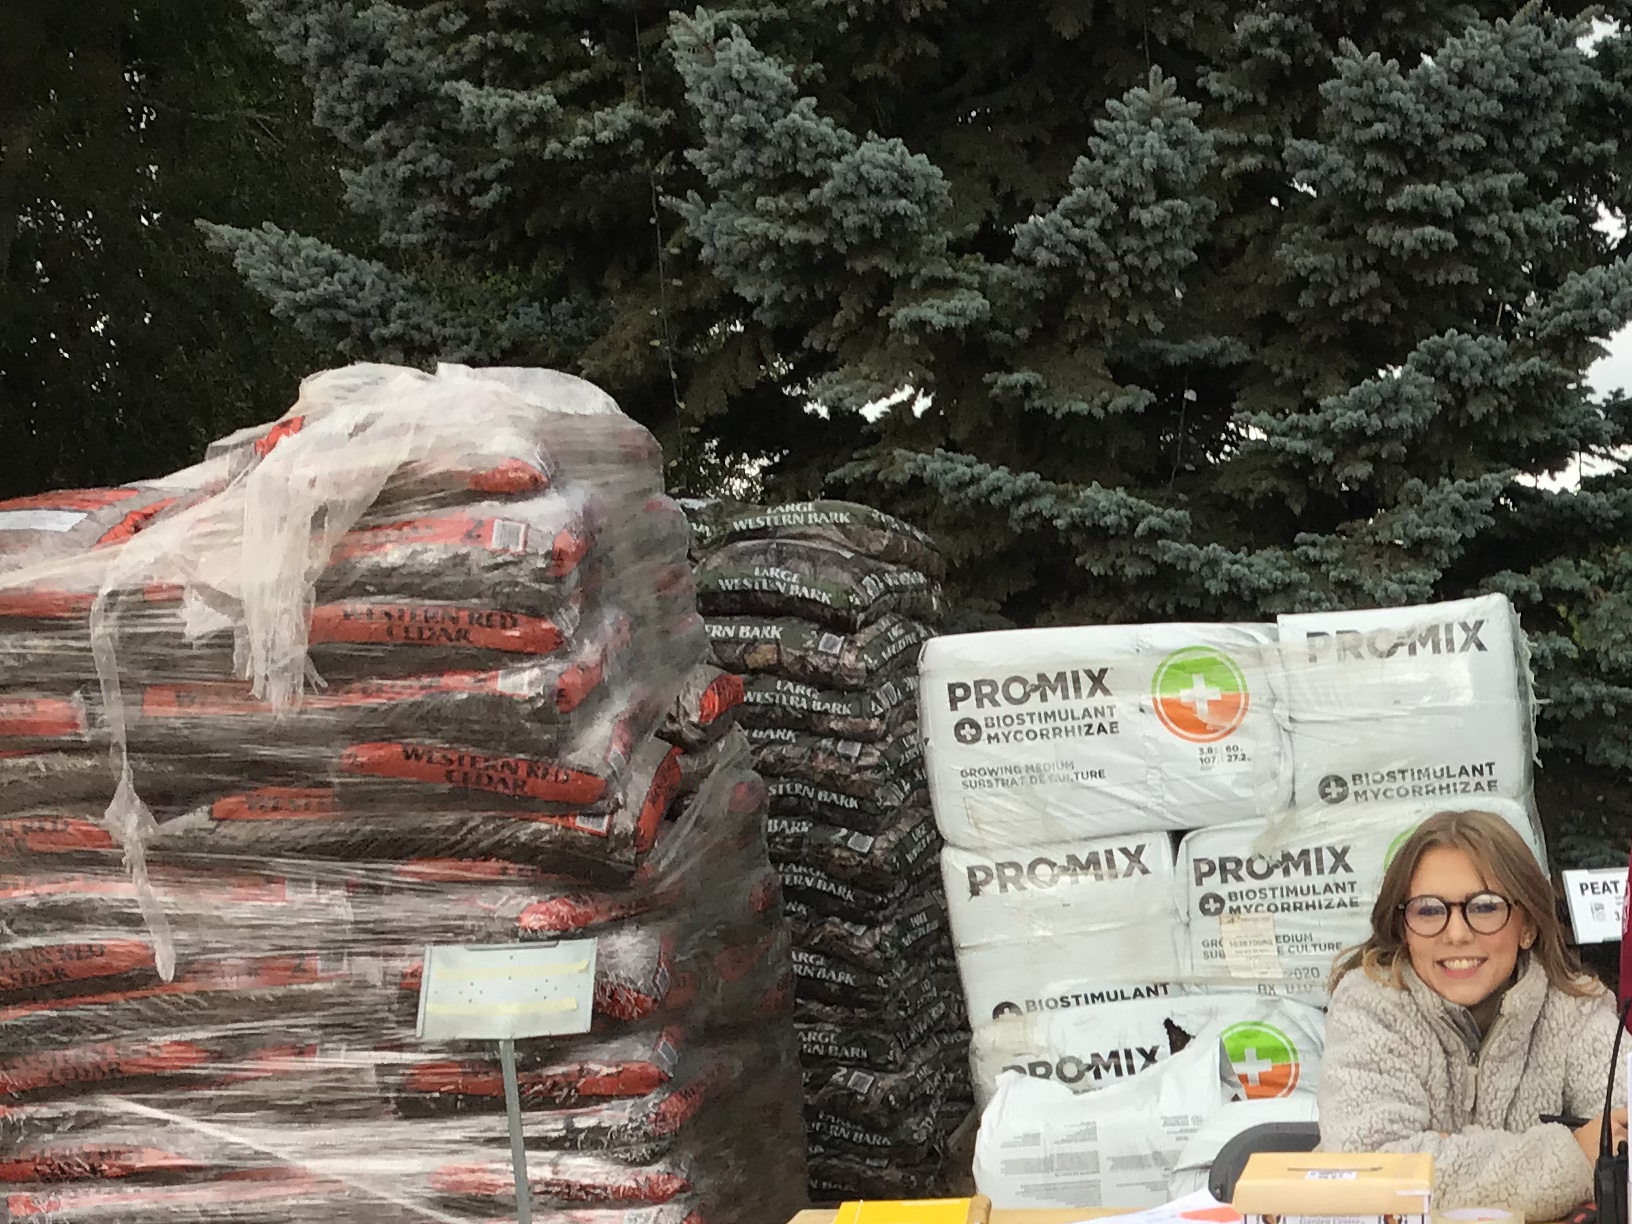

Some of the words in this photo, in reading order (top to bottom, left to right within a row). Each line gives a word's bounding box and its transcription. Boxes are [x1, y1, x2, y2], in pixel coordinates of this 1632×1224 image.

[733, 512, 806, 531] WESTERN
[808, 511, 851, 524] BARK
[754, 566, 800, 583] LARGE
[718, 578, 787, 596] WESTERN
[789, 584, 833, 605] BARK
[467, 611, 520, 628] RED
[386, 625, 472, 643] CEDAR
[739, 625, 784, 640] BARK
[811, 699, 852, 715] BARK
[984, 704, 1117, 728] BIOSTIMULANT
[987, 721, 1120, 744] MYCORRHIZAE
[403, 748, 520, 775] WESTERN
[960, 764, 1022, 778] GROWING
[1025, 759, 1075, 774] MEDIUM
[446, 769, 528, 793] CEDAR
[961, 775, 1026, 790] SUBSTRAT
[1029, 774, 1047, 786] DE
[1351, 762, 1496, 786] BIOSTIMULANT
[817, 791, 859, 809] BARK
[1353, 780, 1498, 802] MYCORRHIZAE
[767, 819, 813, 834] BARK
[816, 880, 856, 901] BARK
[1227, 881, 1358, 903] BIOSTIMULANT
[1579, 880, 1620, 896] PEAT
[1228, 897, 1360, 914] MYCORRHIZAE
[1275, 932, 1314, 944] EDIUM
[1288, 941, 1343, 954] CULTURE
[816, 966, 857, 987] BARK
[1025, 983, 1170, 1013] BIOSTIMULANT
[828, 1046, 868, 1059] BARK
